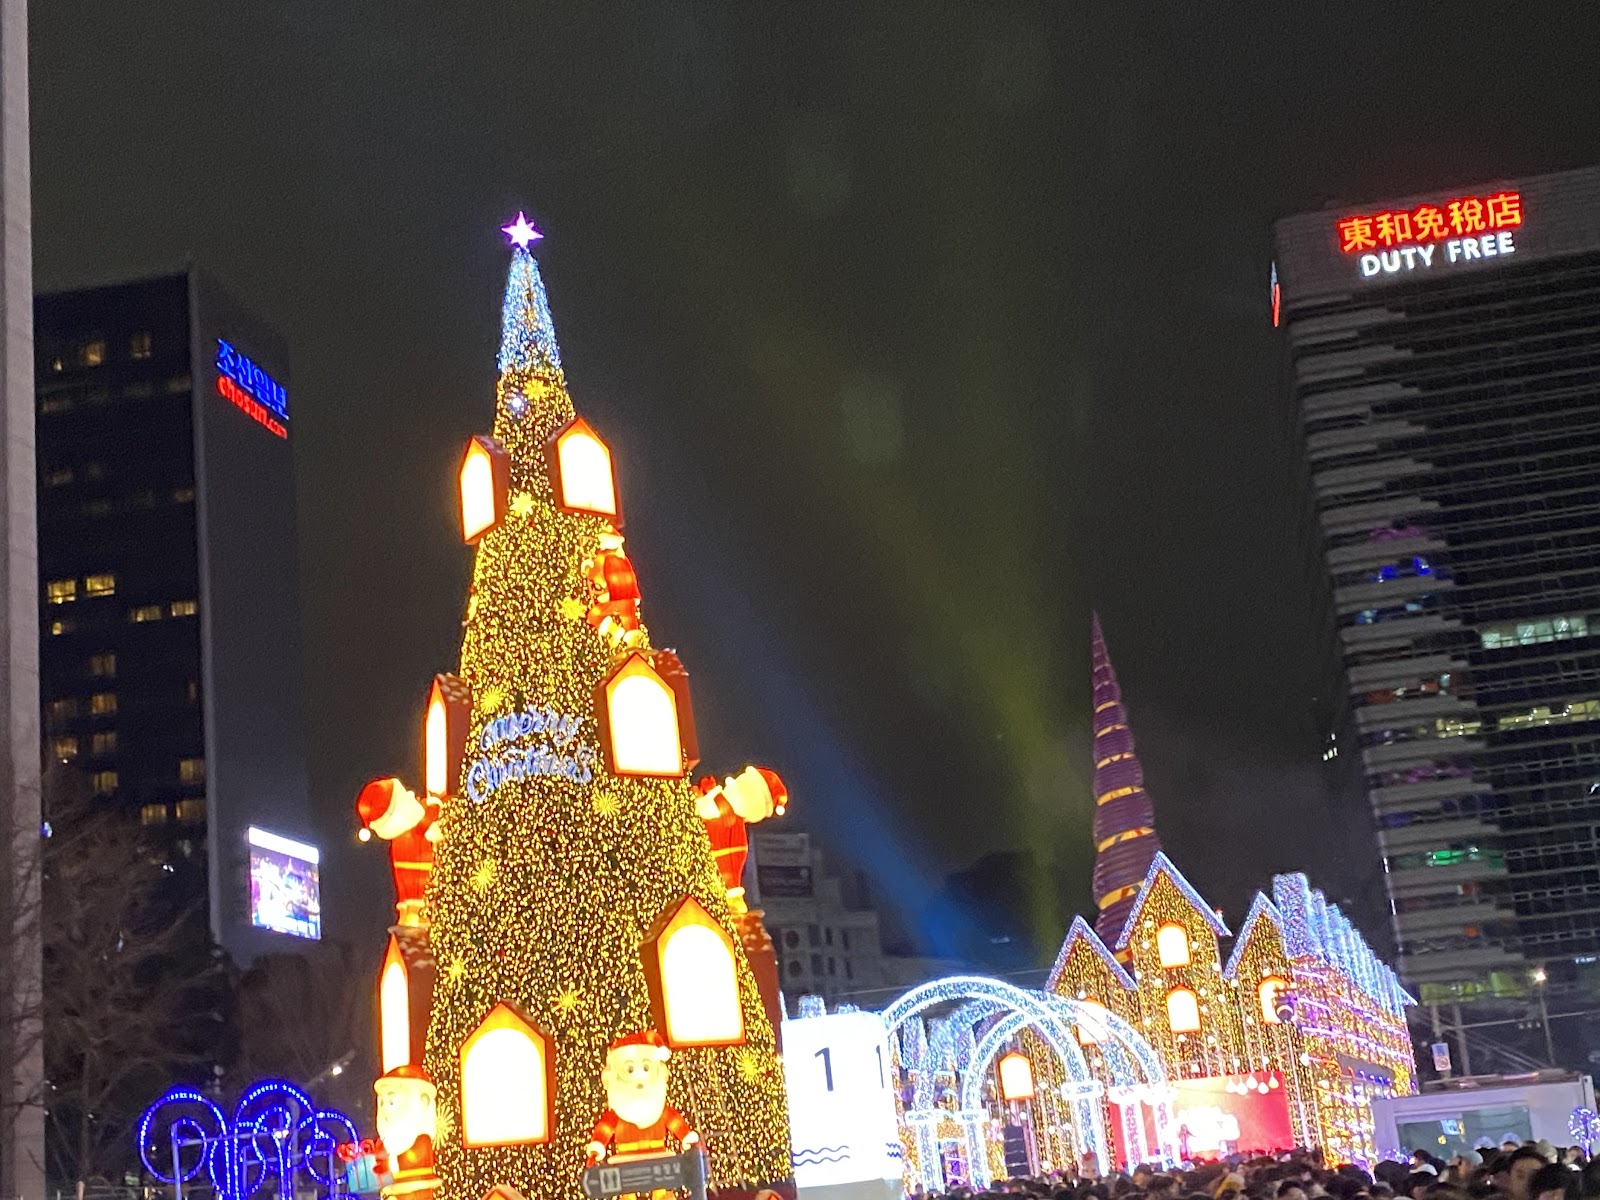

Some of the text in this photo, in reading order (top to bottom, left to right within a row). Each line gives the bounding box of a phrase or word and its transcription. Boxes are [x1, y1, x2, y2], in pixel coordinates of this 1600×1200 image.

[1361, 231, 1516, 277] DUTY FREE
[216, 338, 289, 420] 조선일보
[814, 1047, 834, 1092] 1
